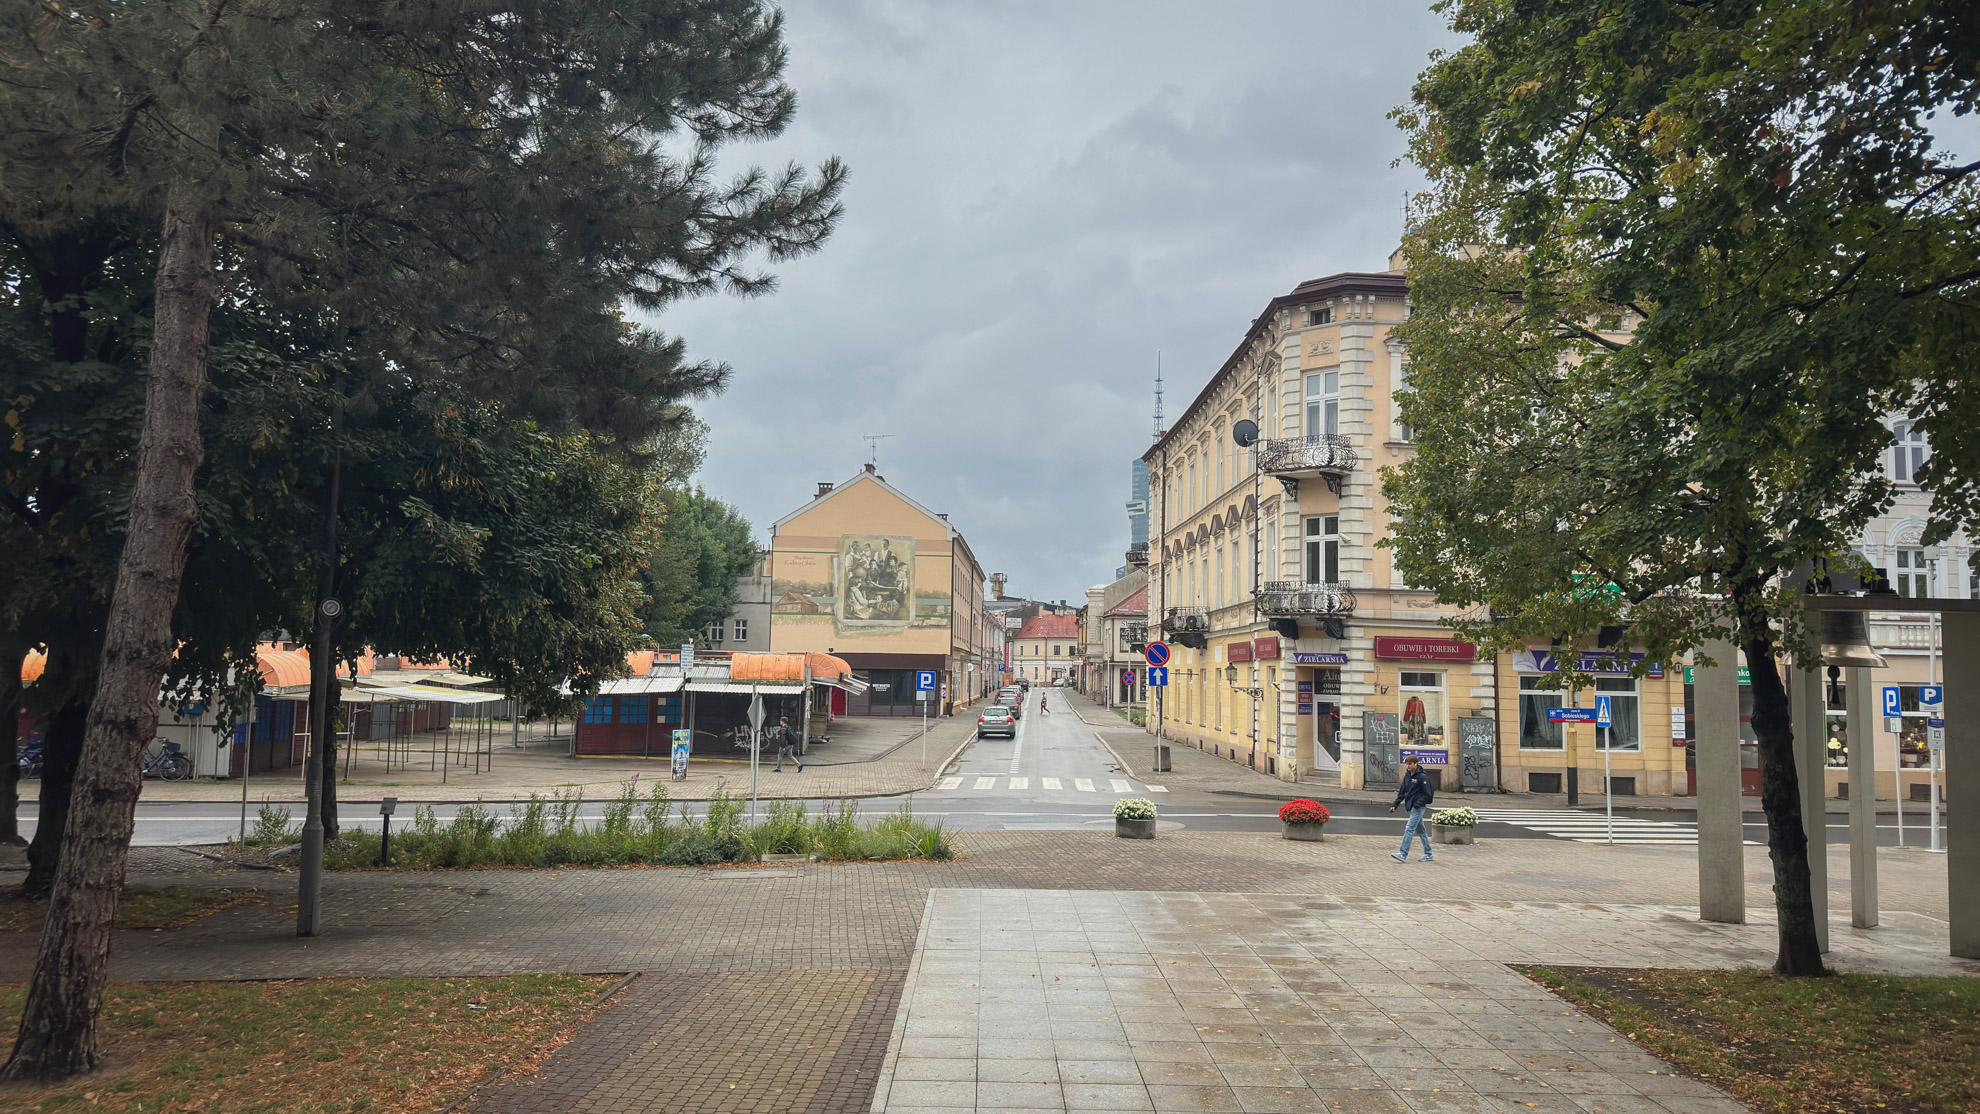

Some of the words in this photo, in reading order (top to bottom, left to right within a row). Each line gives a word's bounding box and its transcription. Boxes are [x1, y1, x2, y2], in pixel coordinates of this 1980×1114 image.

[1393, 644, 1423, 652] OBUWIE
[1428, 645, 1459, 653] TOREBKI
[920, 673, 932, 689] P
[1886, 690, 1897, 713] P
[1924, 688, 1937, 701] P
